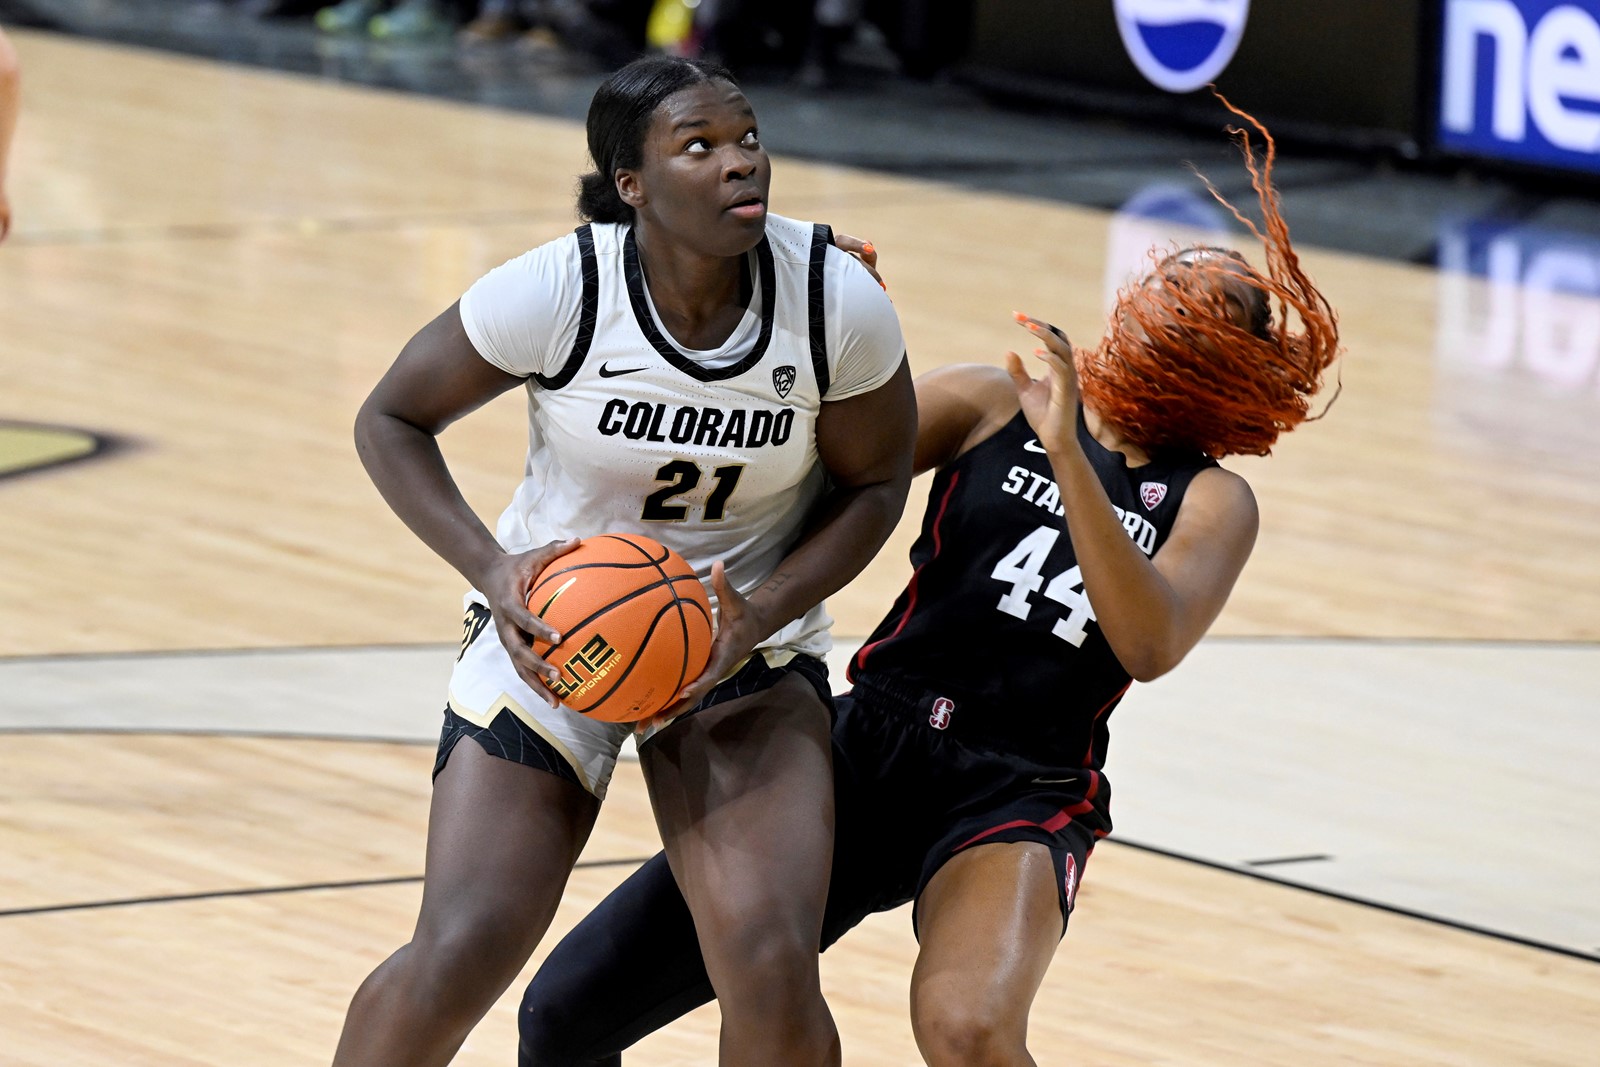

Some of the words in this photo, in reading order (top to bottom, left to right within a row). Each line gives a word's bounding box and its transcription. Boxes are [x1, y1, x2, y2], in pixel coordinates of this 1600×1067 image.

[778, 379, 790, 391] 12
[597, 398, 795, 449] COLORADO
[640, 458, 747, 523] 21
[1001, 465, 1157, 555] STARD
[991, 525, 1097, 649] 44
